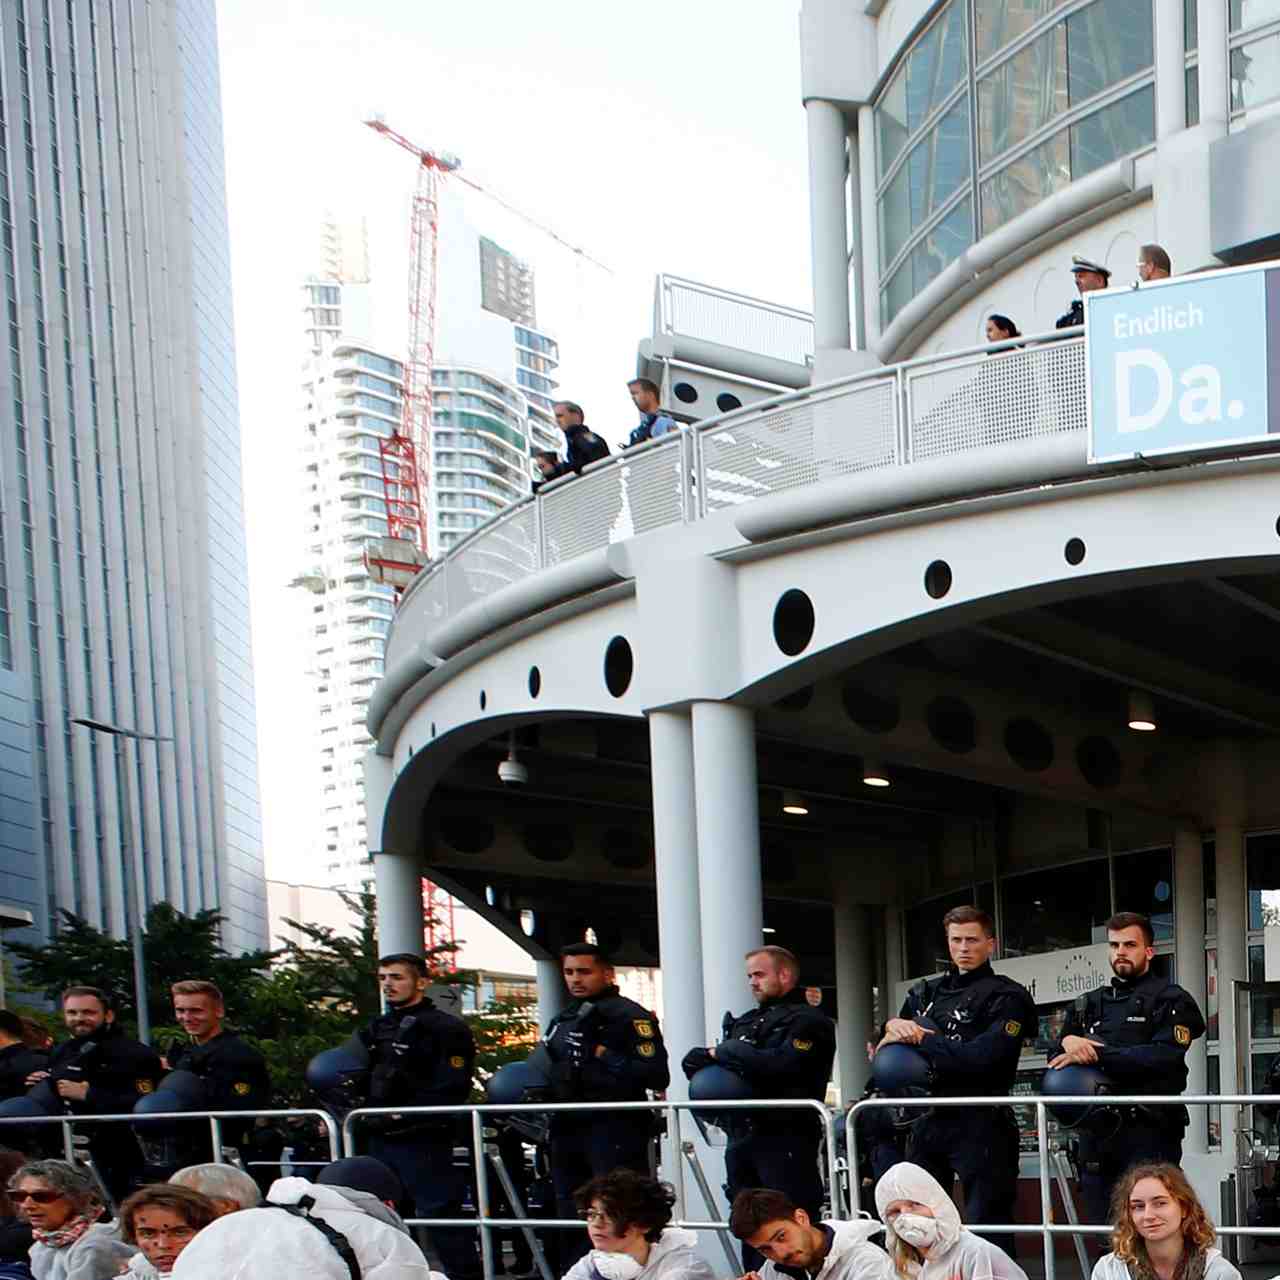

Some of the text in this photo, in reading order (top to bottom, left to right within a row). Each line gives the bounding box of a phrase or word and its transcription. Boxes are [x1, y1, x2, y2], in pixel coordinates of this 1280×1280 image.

[1113, 302, 1204, 340] Endlich
[1113, 348, 1246, 434] Da.
[1056, 966, 1105, 993] festhalle
